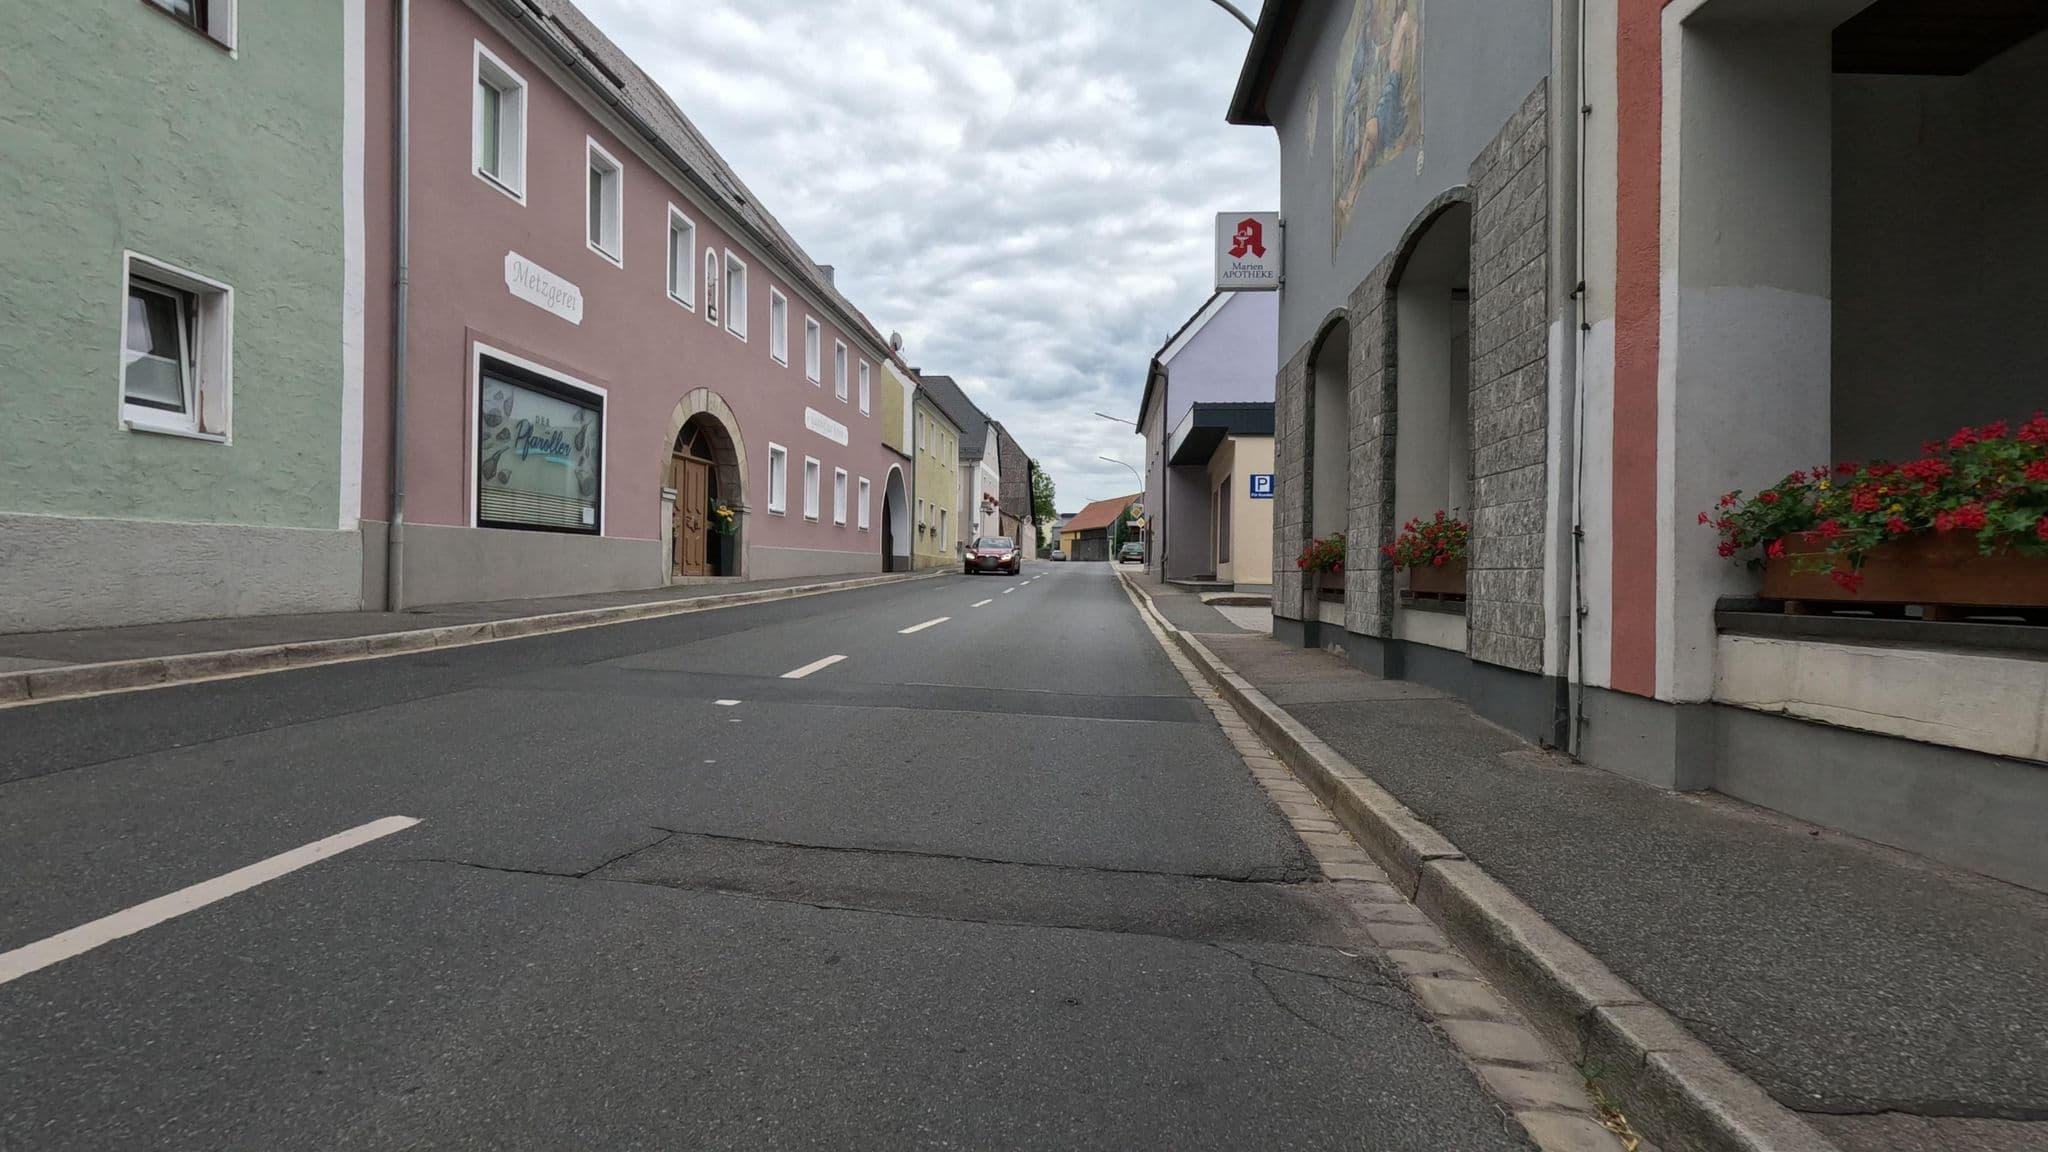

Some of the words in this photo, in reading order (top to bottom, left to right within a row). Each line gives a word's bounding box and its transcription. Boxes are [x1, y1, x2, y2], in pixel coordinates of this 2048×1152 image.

[1232, 262, 1263, 271] Marien
[1222, 270, 1274, 279] APOTHEKE
[512, 260, 576, 311] Metzgerei
[1257, 477, 1268, 491] P
